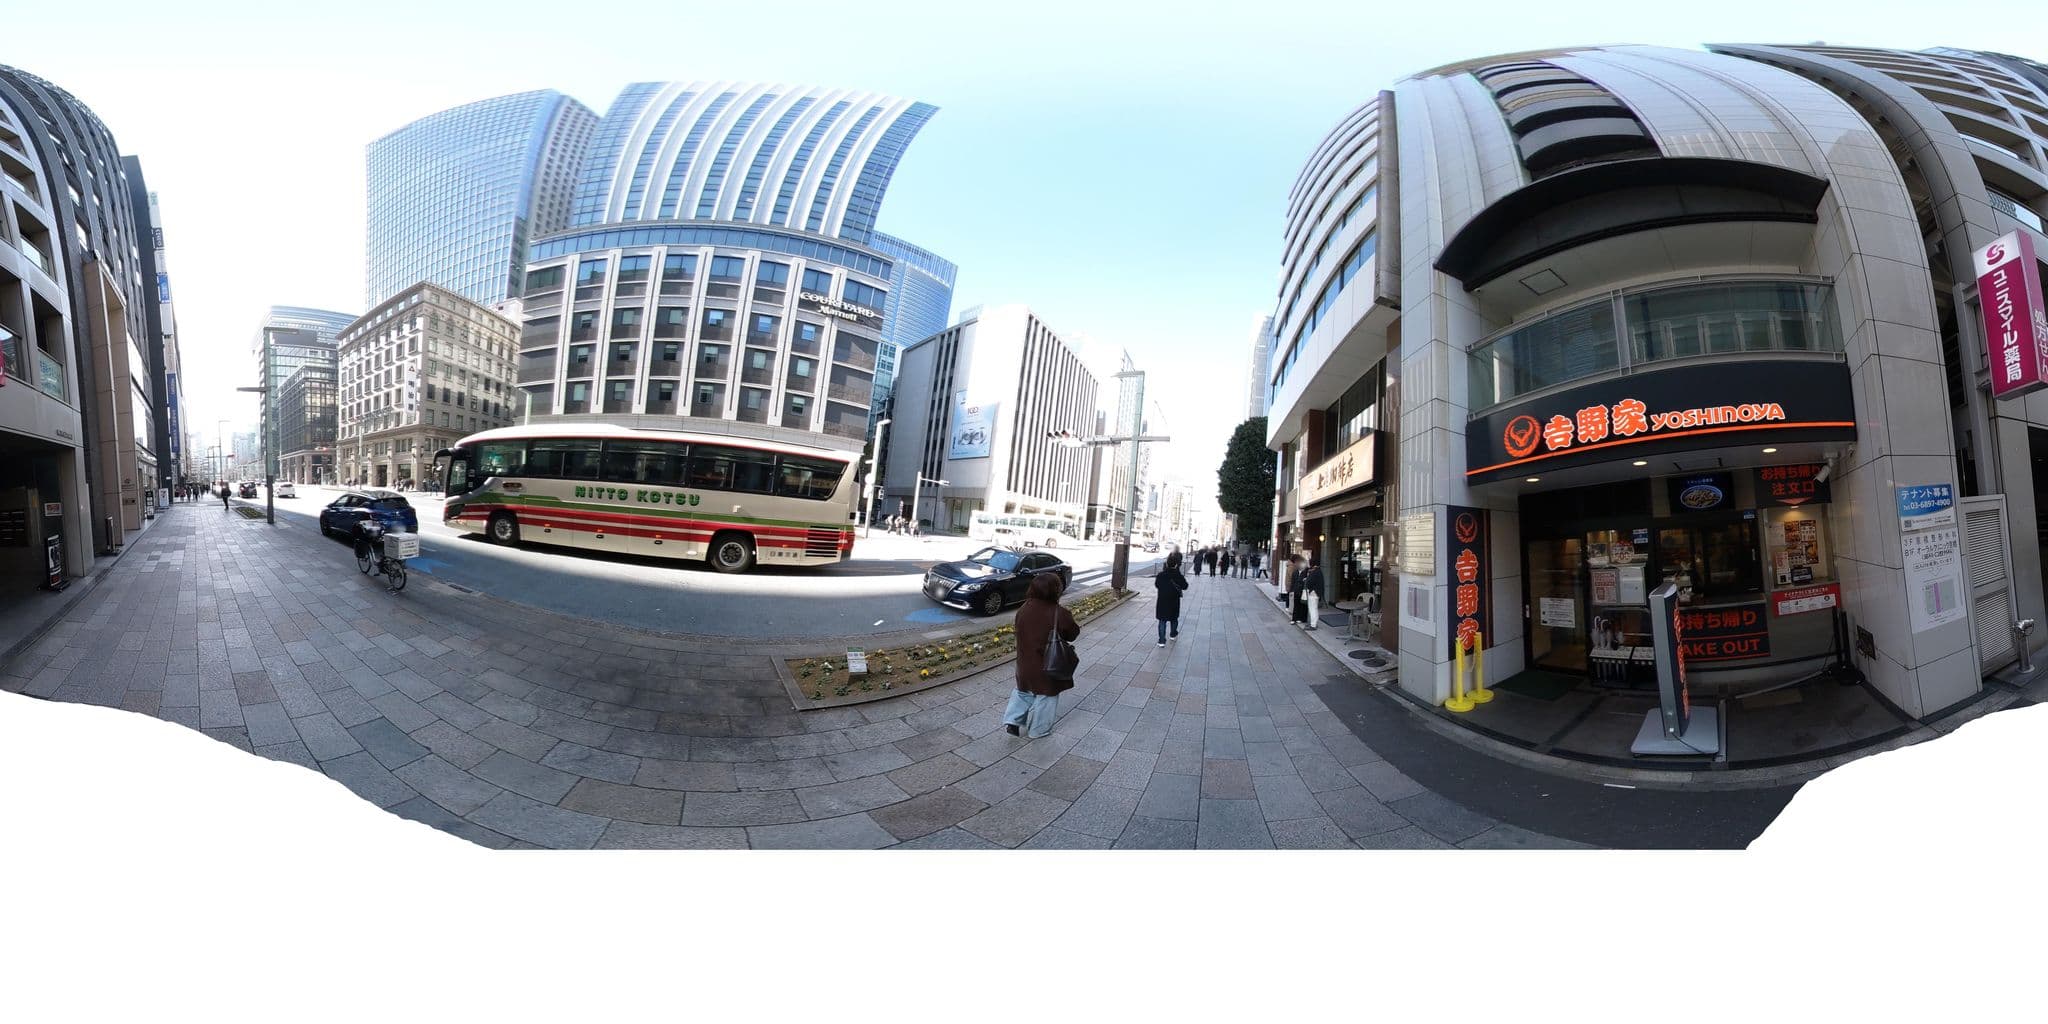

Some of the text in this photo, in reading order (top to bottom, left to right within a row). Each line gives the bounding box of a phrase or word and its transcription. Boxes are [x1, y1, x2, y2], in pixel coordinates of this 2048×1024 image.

[800, 291, 875, 318] COURTYARD
[817, 306, 857, 321] Marriott
[1992, 269, 2022, 384] ユニスマイル薬局
[574, 485, 700, 506] NITTO KOTSU
[1772, 480, 1815, 496] 注文口
[1901, 487, 1950, 500] テナント募集
[1723, 639, 1762, 653] OUT
